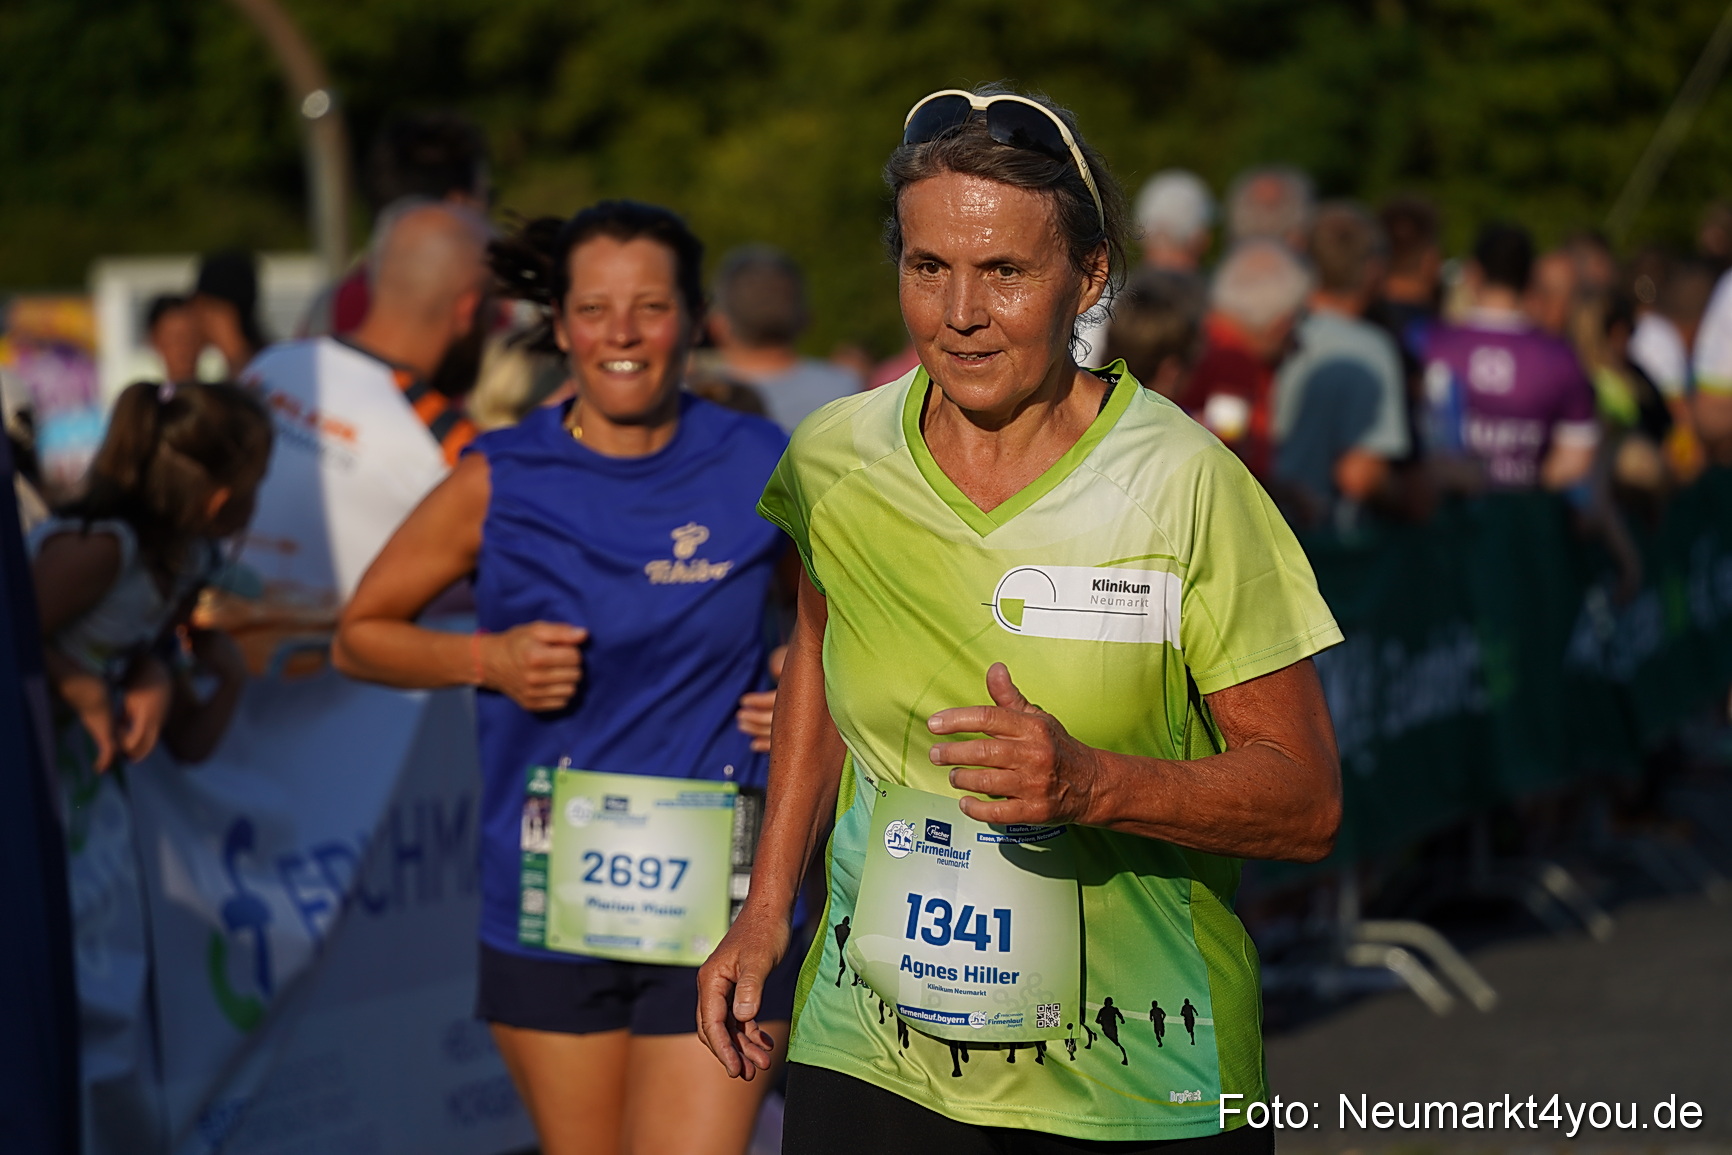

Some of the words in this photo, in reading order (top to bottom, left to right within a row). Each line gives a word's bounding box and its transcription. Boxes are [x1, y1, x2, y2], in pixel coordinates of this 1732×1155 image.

[1092, 578, 1150, 594] Klinikum
[1090, 594, 1149, 608] Neumarkt
[930, 829, 950, 839] Fischer
[915, 840, 972, 861] Firmenlauf
[583, 851, 688, 891] 2697
[936, 858, 970, 869] neumarkt
[905, 892, 1011, 952] 1341
[899, 954, 958, 981] Agnes
[964, 965, 1020, 985] Hiller
[927, 983, 954, 994] Klinikum
[954, 988, 987, 997] Neumarkt
[899, 1006, 965, 1025] firmenlauf.bayern
[987, 1017, 1024, 1025] Firmenlauf
